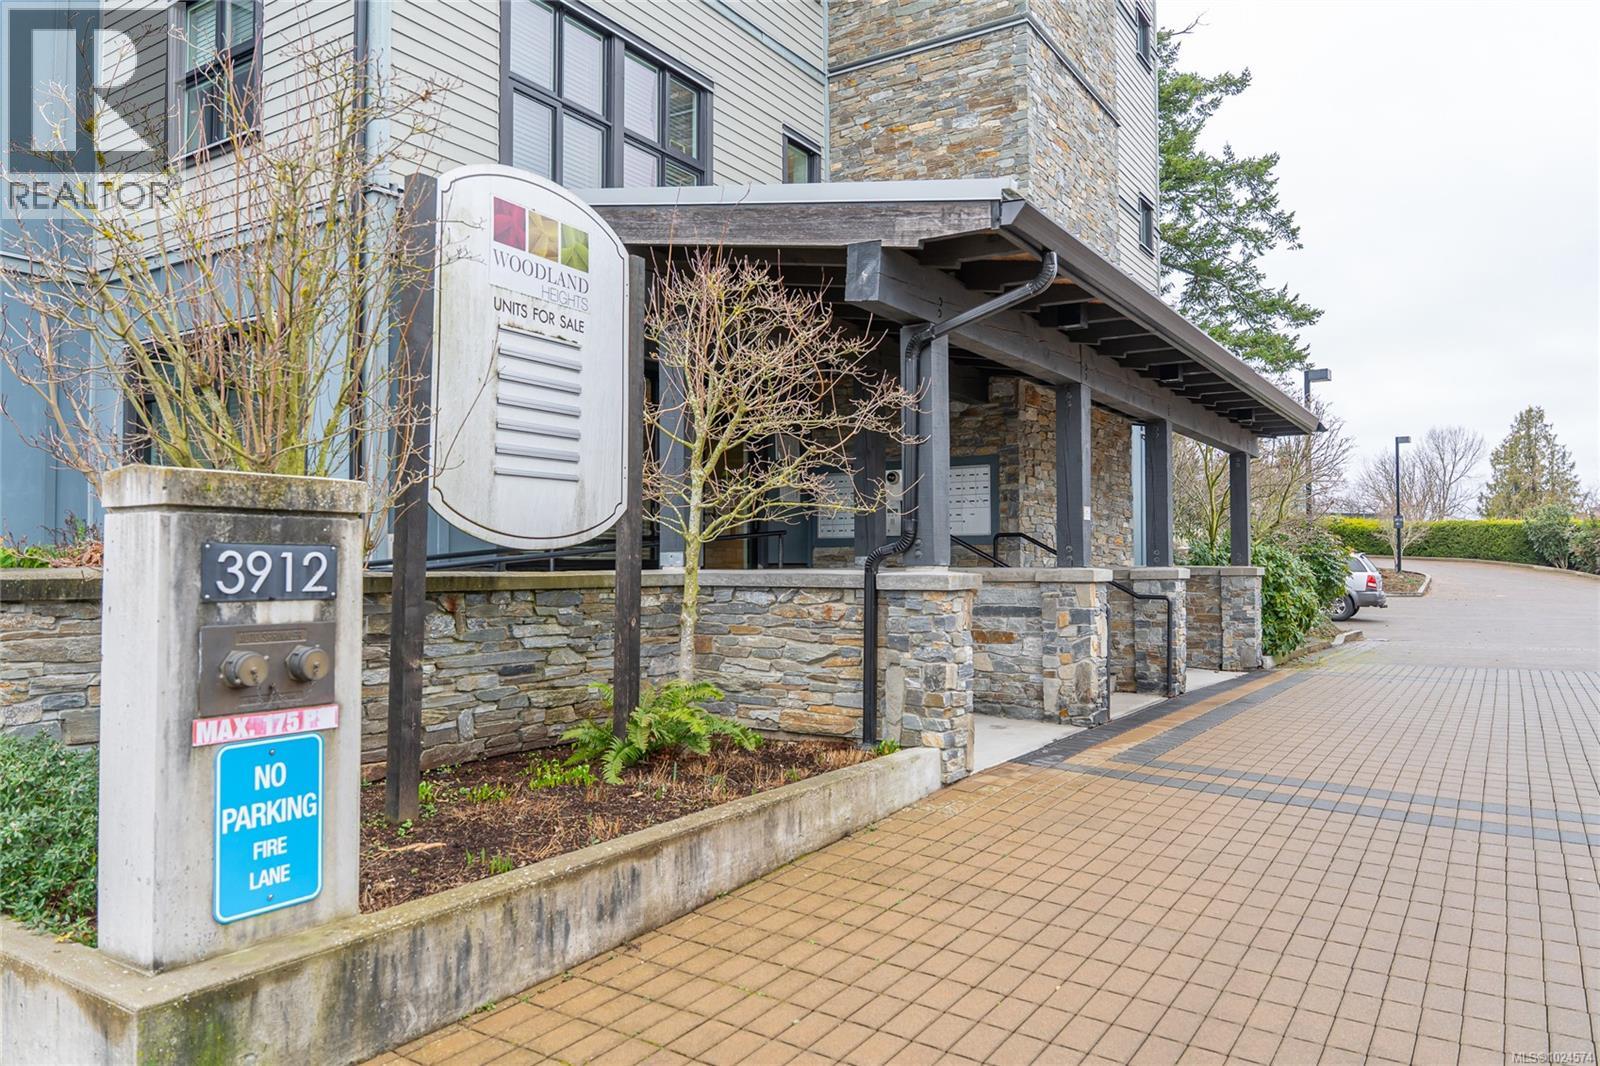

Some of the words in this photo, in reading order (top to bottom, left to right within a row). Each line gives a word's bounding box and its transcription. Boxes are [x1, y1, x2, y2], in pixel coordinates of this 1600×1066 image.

[493, 248, 589, 294] WOODLAND
[493, 296, 528, 319] UNITS
[532, 307, 556, 326] FOR
[559, 315, 585, 334] SALE
[541, 284, 589, 312] HEIGHTS
[215, 549, 329, 595] 3912
[196, 717, 256, 746] MAX.
[263, 709, 301, 738] 175
[254, 762, 287, 791] NO
[221, 792, 318, 835] PARKING
[253, 836, 288, 860] FIRE
[249, 864, 291, 890] LANE
